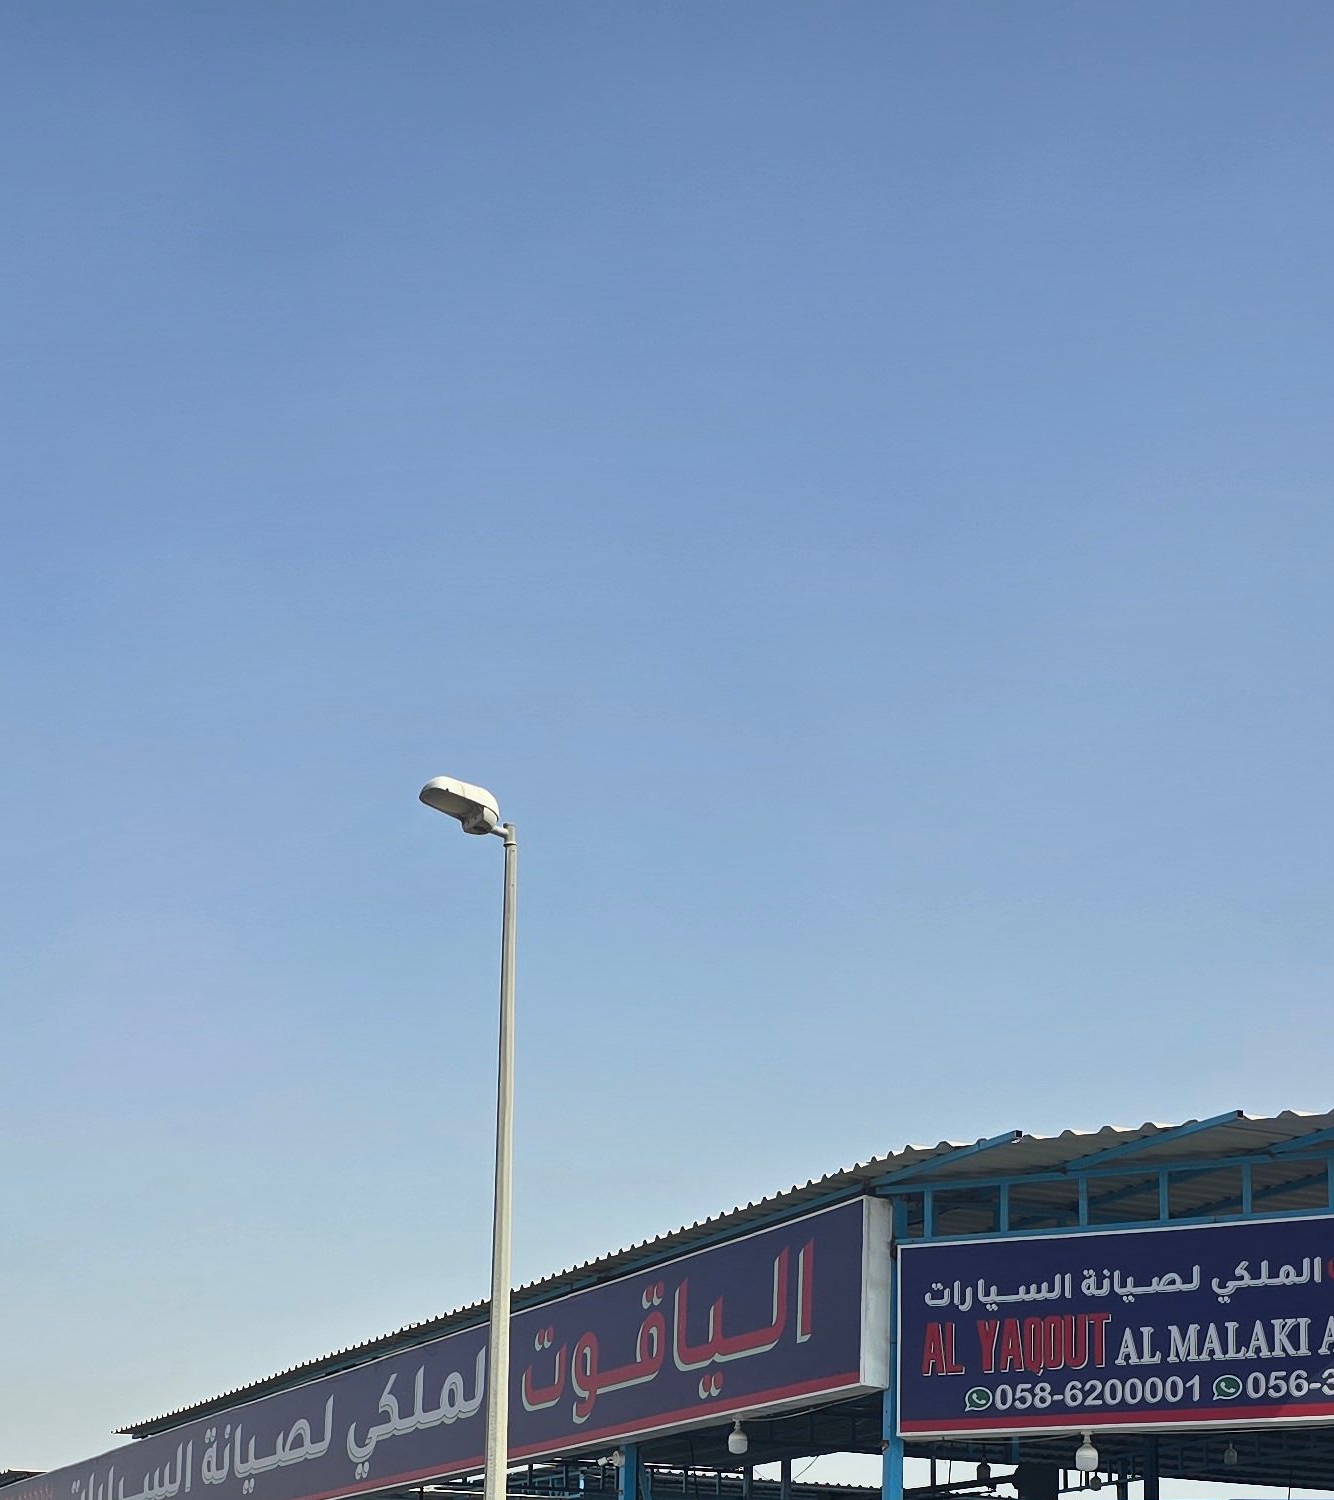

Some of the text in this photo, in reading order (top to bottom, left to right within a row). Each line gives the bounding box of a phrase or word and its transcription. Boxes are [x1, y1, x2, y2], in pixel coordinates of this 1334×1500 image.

[923, 1272, 1073, 1313] السيارات
[1080, 1264, 1201, 1304] لصيانة
[1211, 1256, 1323, 1304] الملكي
[521, 1236, 816, 1425] الياقوت
[921, 1322, 966, 1377] AL
[976, 1312, 1112, 1376] YAQOUT
[1114, 1326, 1163, 1367] AL
[1166, 1317, 1311, 1364] MALAKI
[346, 1344, 487, 1480] لملكي
[995, 1374, 1201, 1411] 058-6200001
[201, 1393, 335, 1495] لصيانة
